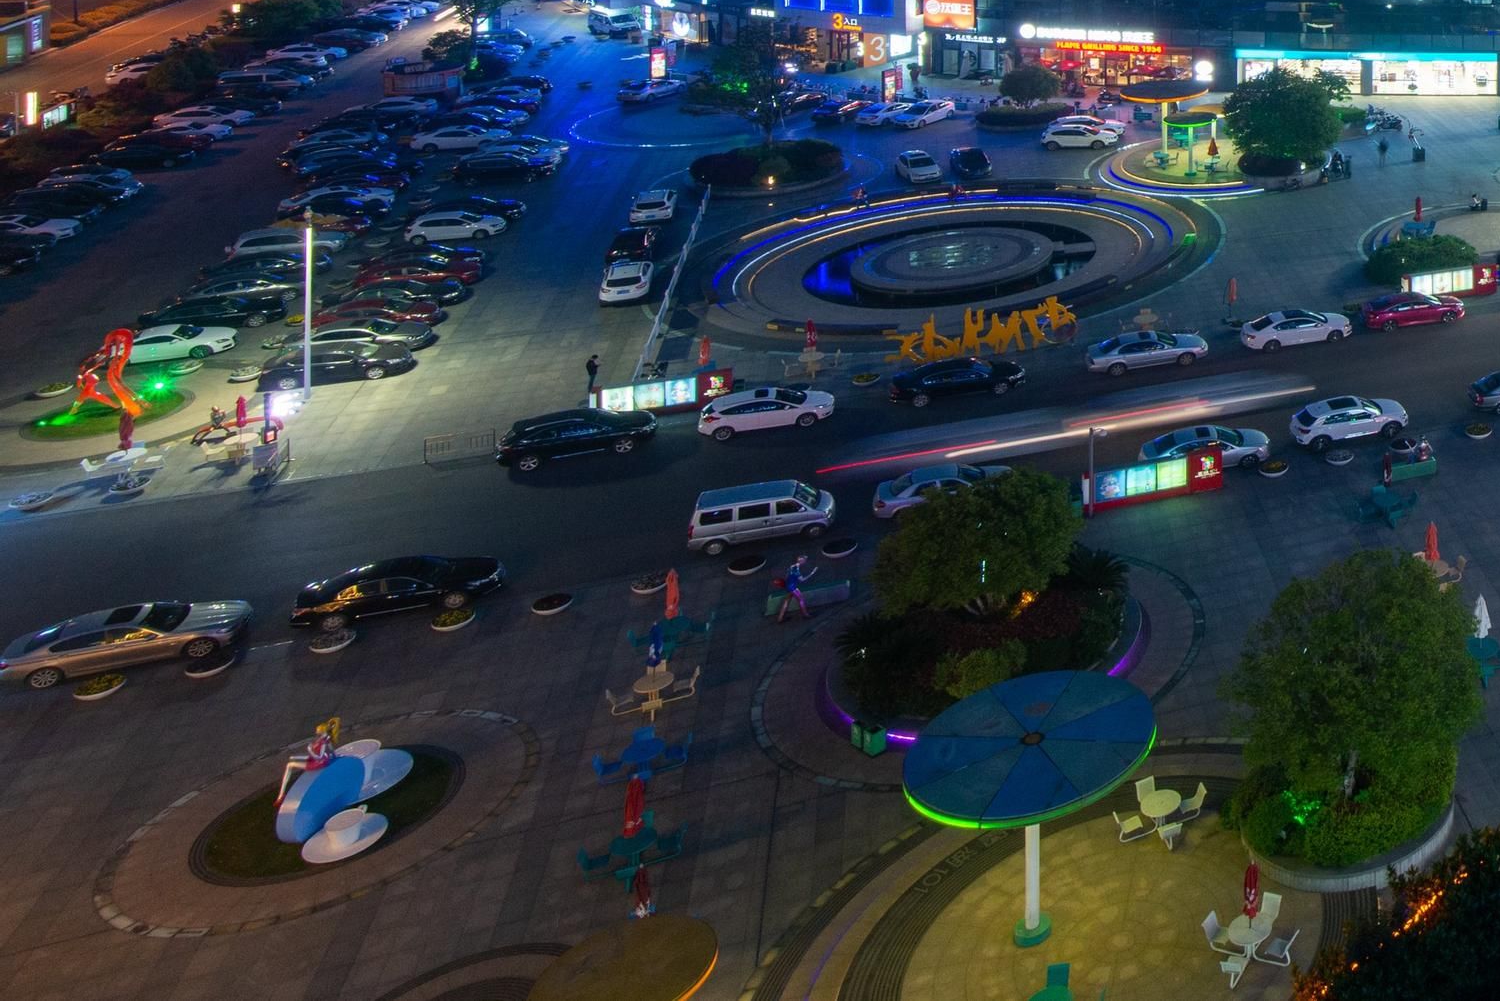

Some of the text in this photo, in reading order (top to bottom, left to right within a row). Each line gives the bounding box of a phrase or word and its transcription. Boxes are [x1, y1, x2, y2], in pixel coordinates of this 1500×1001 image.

[832, 13, 843, 30] 3
[869, 36, 885, 62] 3
[1056, 40, 1081, 50] FLAME
[1118, 44, 1140, 52] SINCE
